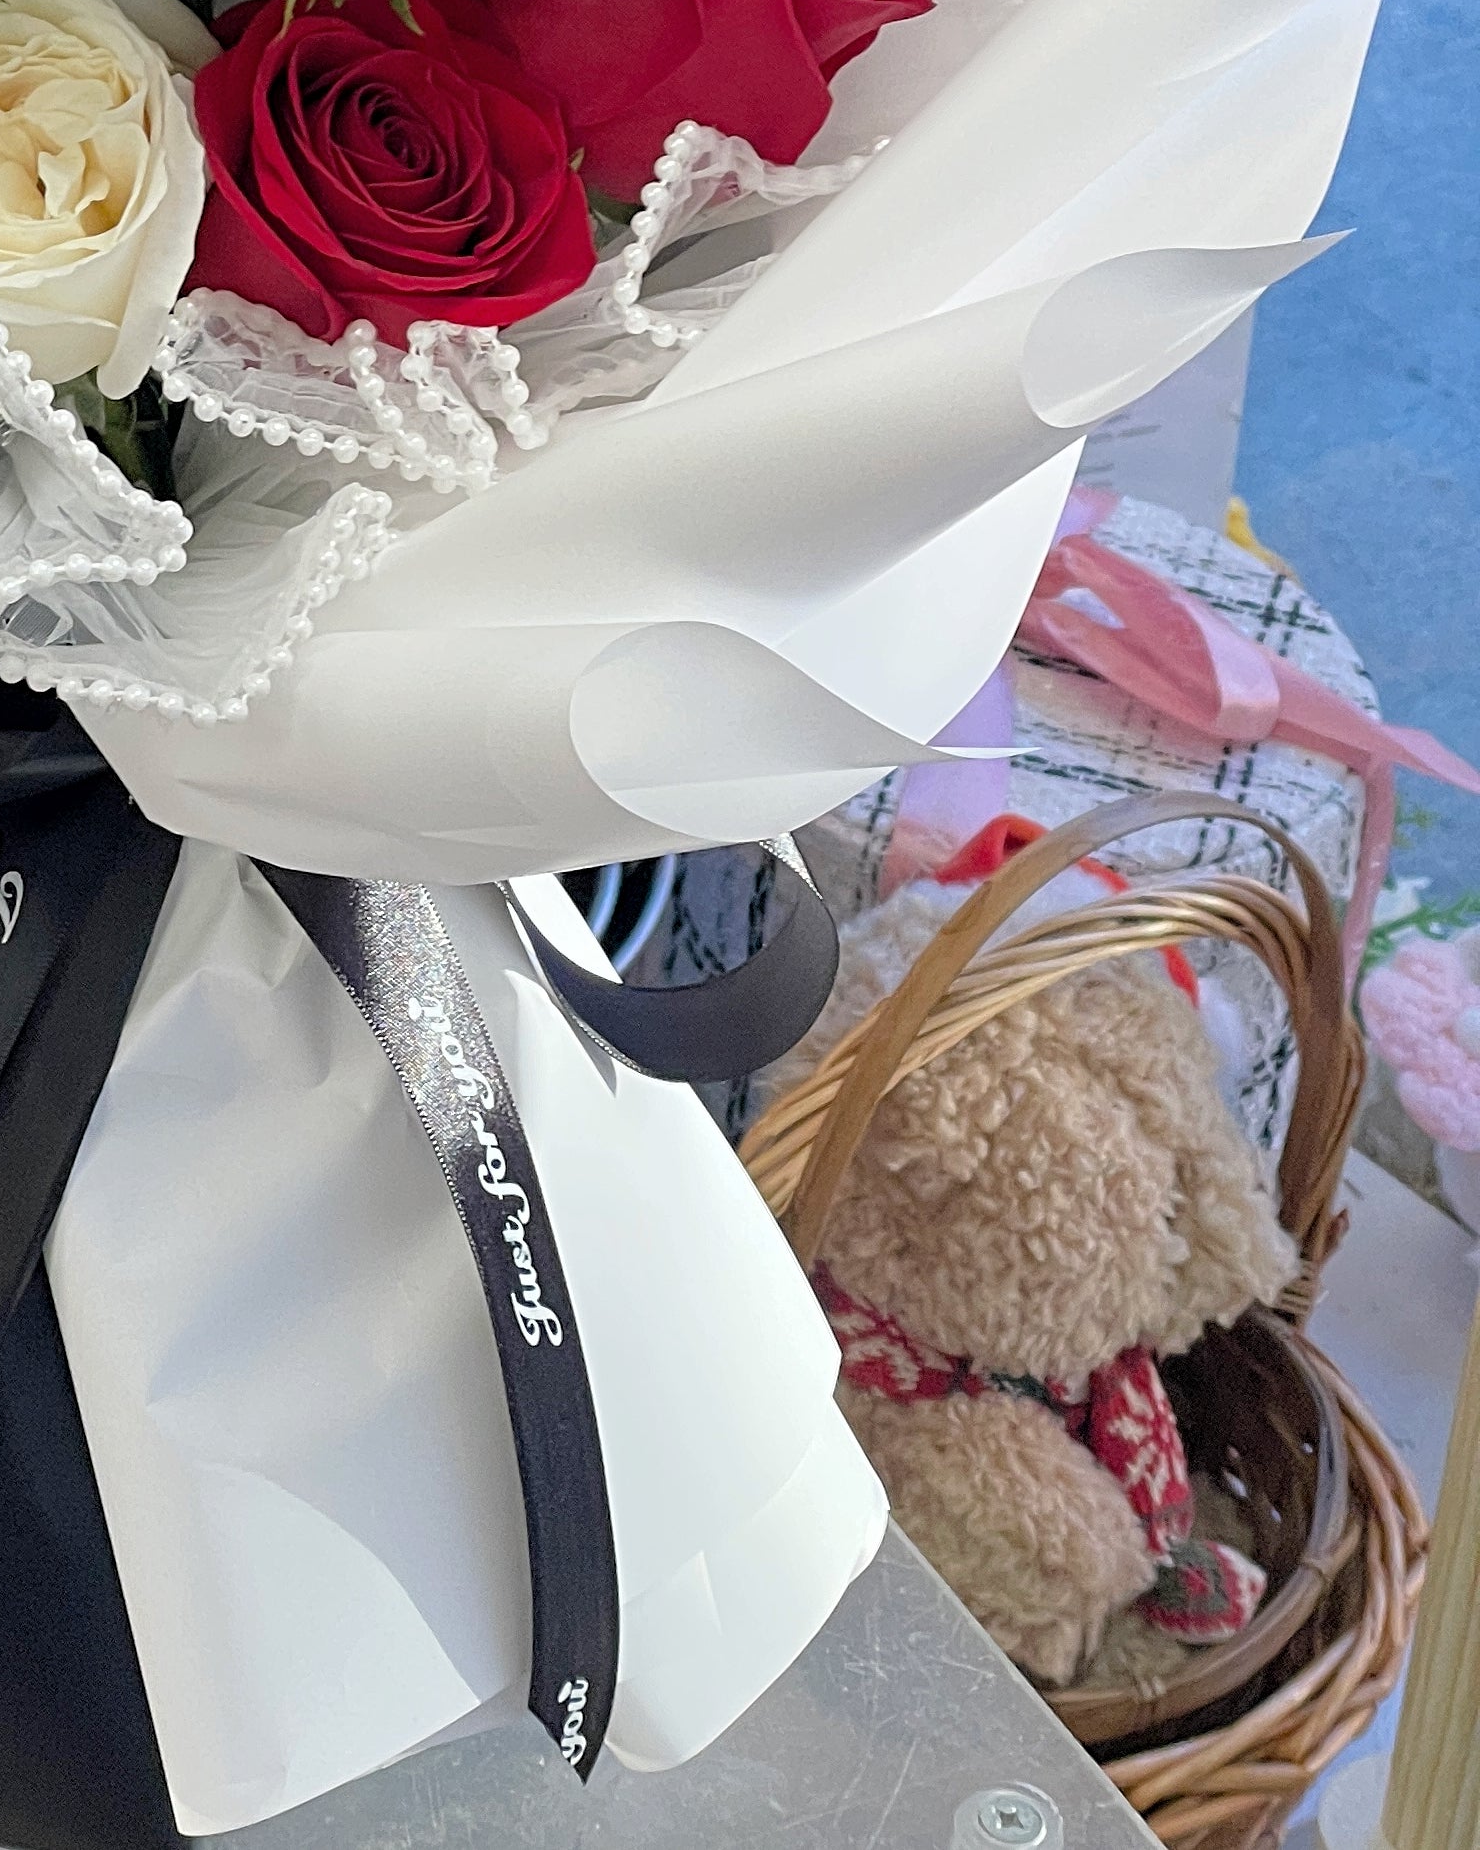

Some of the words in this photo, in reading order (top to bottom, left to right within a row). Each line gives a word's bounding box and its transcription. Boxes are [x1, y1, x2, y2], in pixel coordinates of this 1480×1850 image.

[408, 996, 495, 1110] you
[470, 1111, 531, 1224] for
[502, 1215, 563, 1347] Just
[556, 1679, 589, 1766] you
